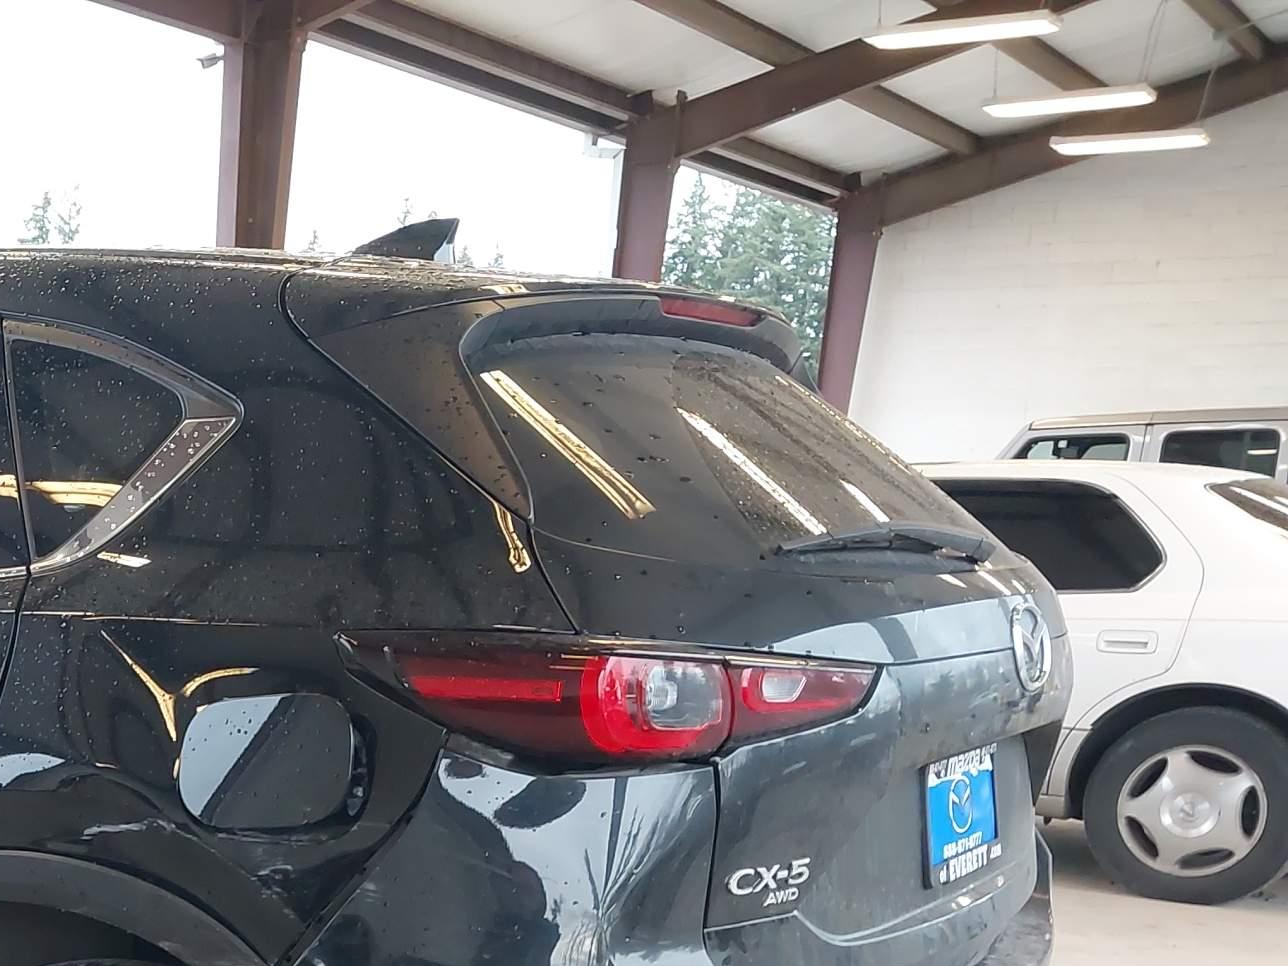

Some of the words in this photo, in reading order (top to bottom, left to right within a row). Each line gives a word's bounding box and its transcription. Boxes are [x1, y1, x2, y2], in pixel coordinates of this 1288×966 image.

[726, 857, 811, 895] CX-5
[949, 843, 988, 881] EVERETT
[763, 887, 799, 907] AWD
